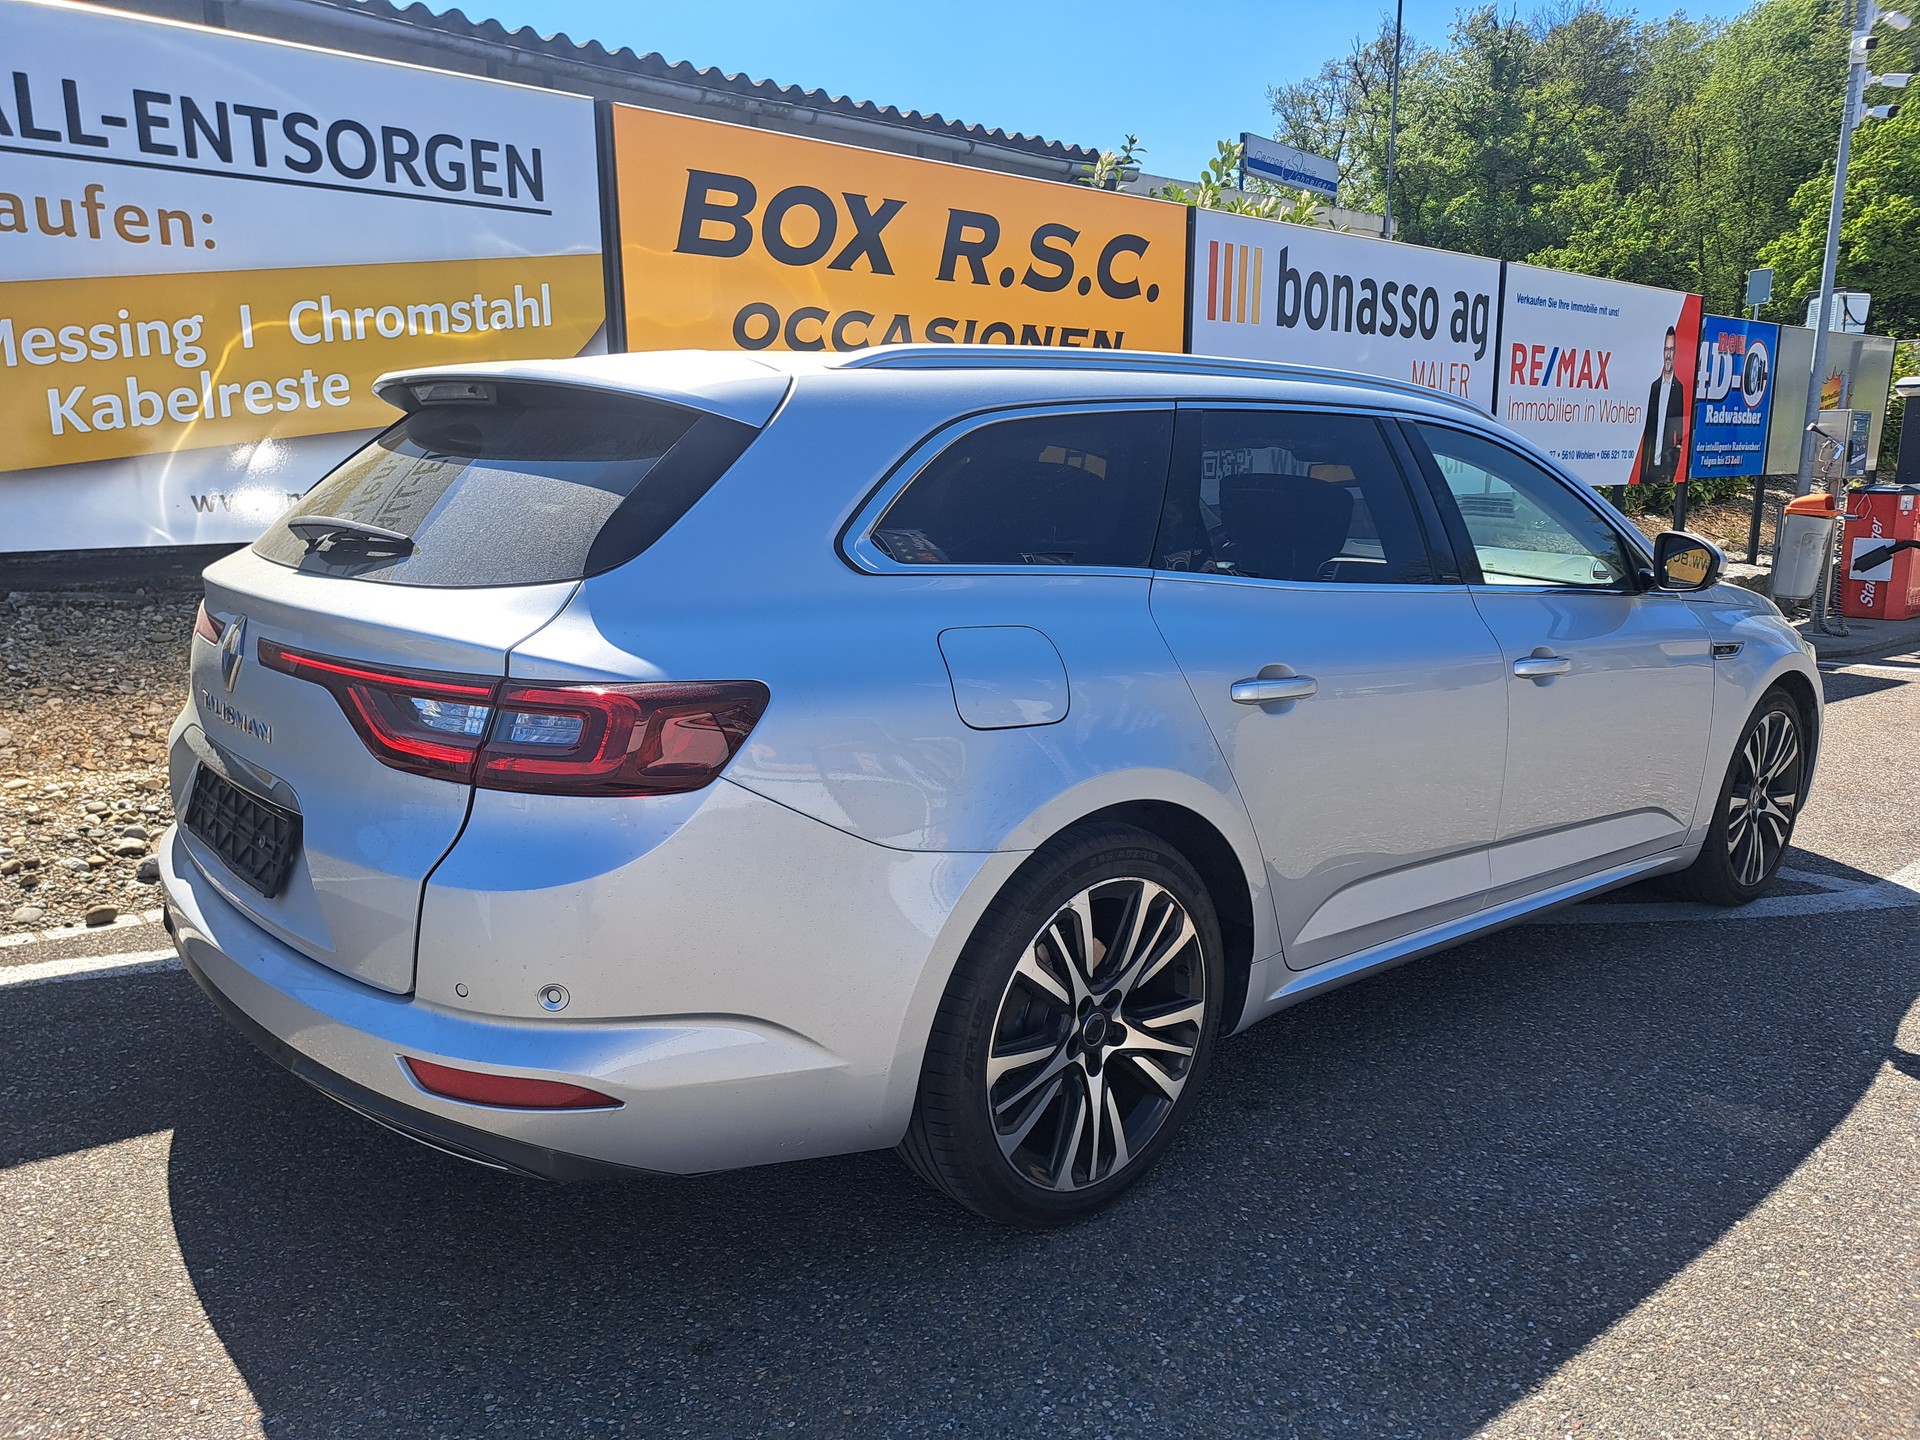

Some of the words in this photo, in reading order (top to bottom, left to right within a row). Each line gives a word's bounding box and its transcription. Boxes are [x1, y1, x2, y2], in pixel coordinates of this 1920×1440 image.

[0, 71, 544, 202] LL-ENTSORGEN
[672, 168, 907, 276] BOX
[935, 207, 1160, 303] R.S.C.
[289, 283, 553, 345] Chromstahl
[1276, 245, 1439, 341] bonasso
[1450, 290, 1490, 361] ag
[1516, 292, 1547, 307] Verkaufen
[1548, 297, 1557, 309] Sie
[1558, 299, 1570, 310] Ihre
[1571, 300, 1598, 314] Immobilie
[1598, 305, 1608, 315] mit
[1608, 307, 1620, 317] uns!
[1510, 342, 1612, 390] RE/MAX
[1718, 332, 1746, 354] neu
[47, 369, 351, 435] Kabelreste
[1507, 395, 1580, 422] Immobilien
[1584, 399, 1595, 422] in
[1600, 400, 1642, 424] Wohlen
[1705, 404, 1762, 425] Radwäscher
[1562, 450, 1575, 460] 5610
[1576, 450, 1596, 459] Wohlen
[1600, 450, 1610, 459] 056
[1611, 450, 1620, 459] 521
[1621, 450, 1627, 459] 72
[1628, 450, 1635, 459] 00
[202, 689, 273, 744] TALISMAN
